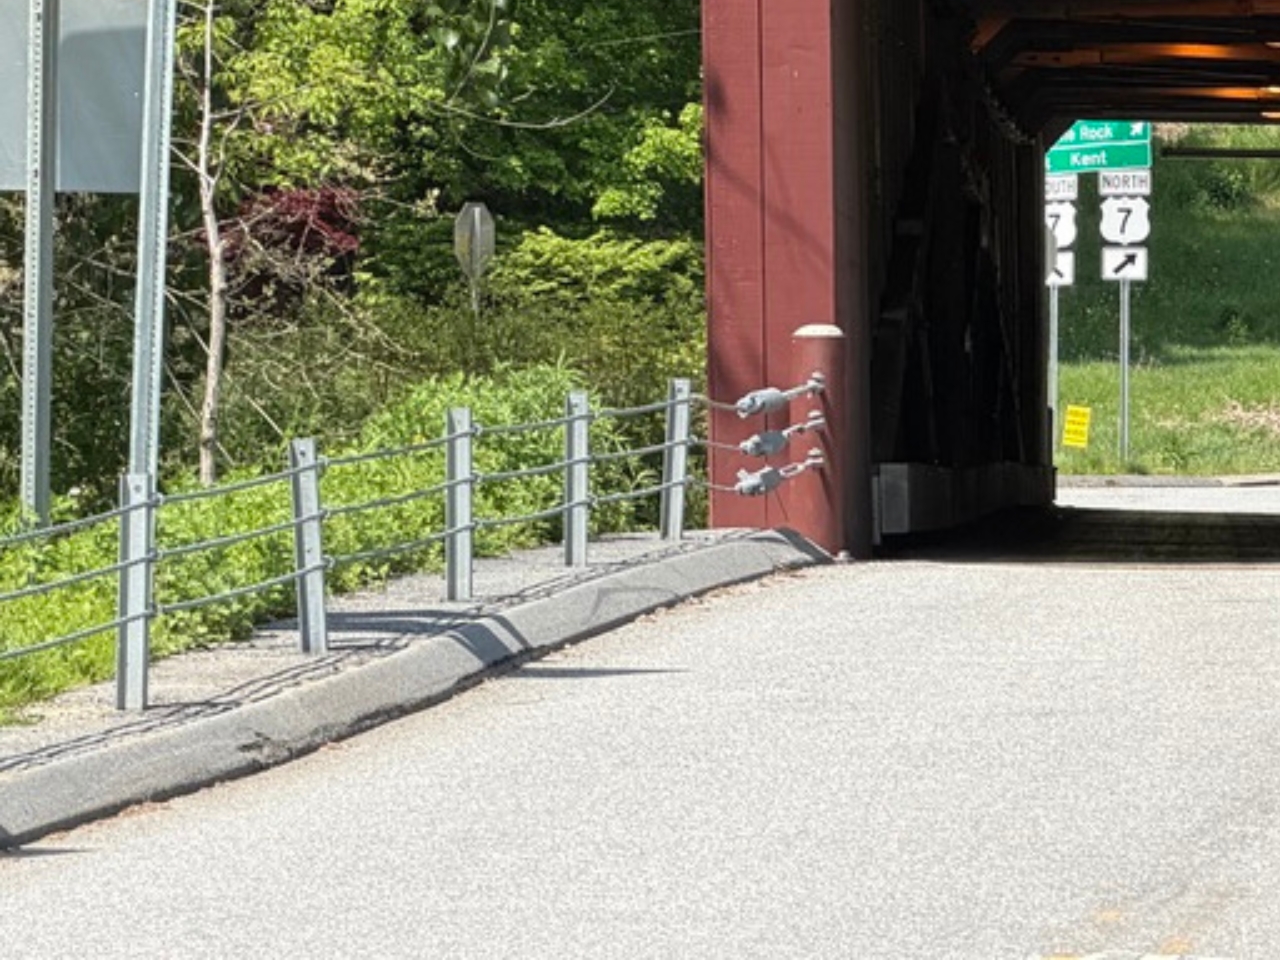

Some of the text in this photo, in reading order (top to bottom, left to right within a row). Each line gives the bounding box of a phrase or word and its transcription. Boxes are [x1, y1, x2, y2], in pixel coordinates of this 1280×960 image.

[1079, 124, 1113, 141] Rock
[1069, 150, 1107, 167] Kent
[1101, 174, 1149, 189] NORTH
[1048, 213, 1061, 231] 7
[1117, 207, 1133, 235] 7
